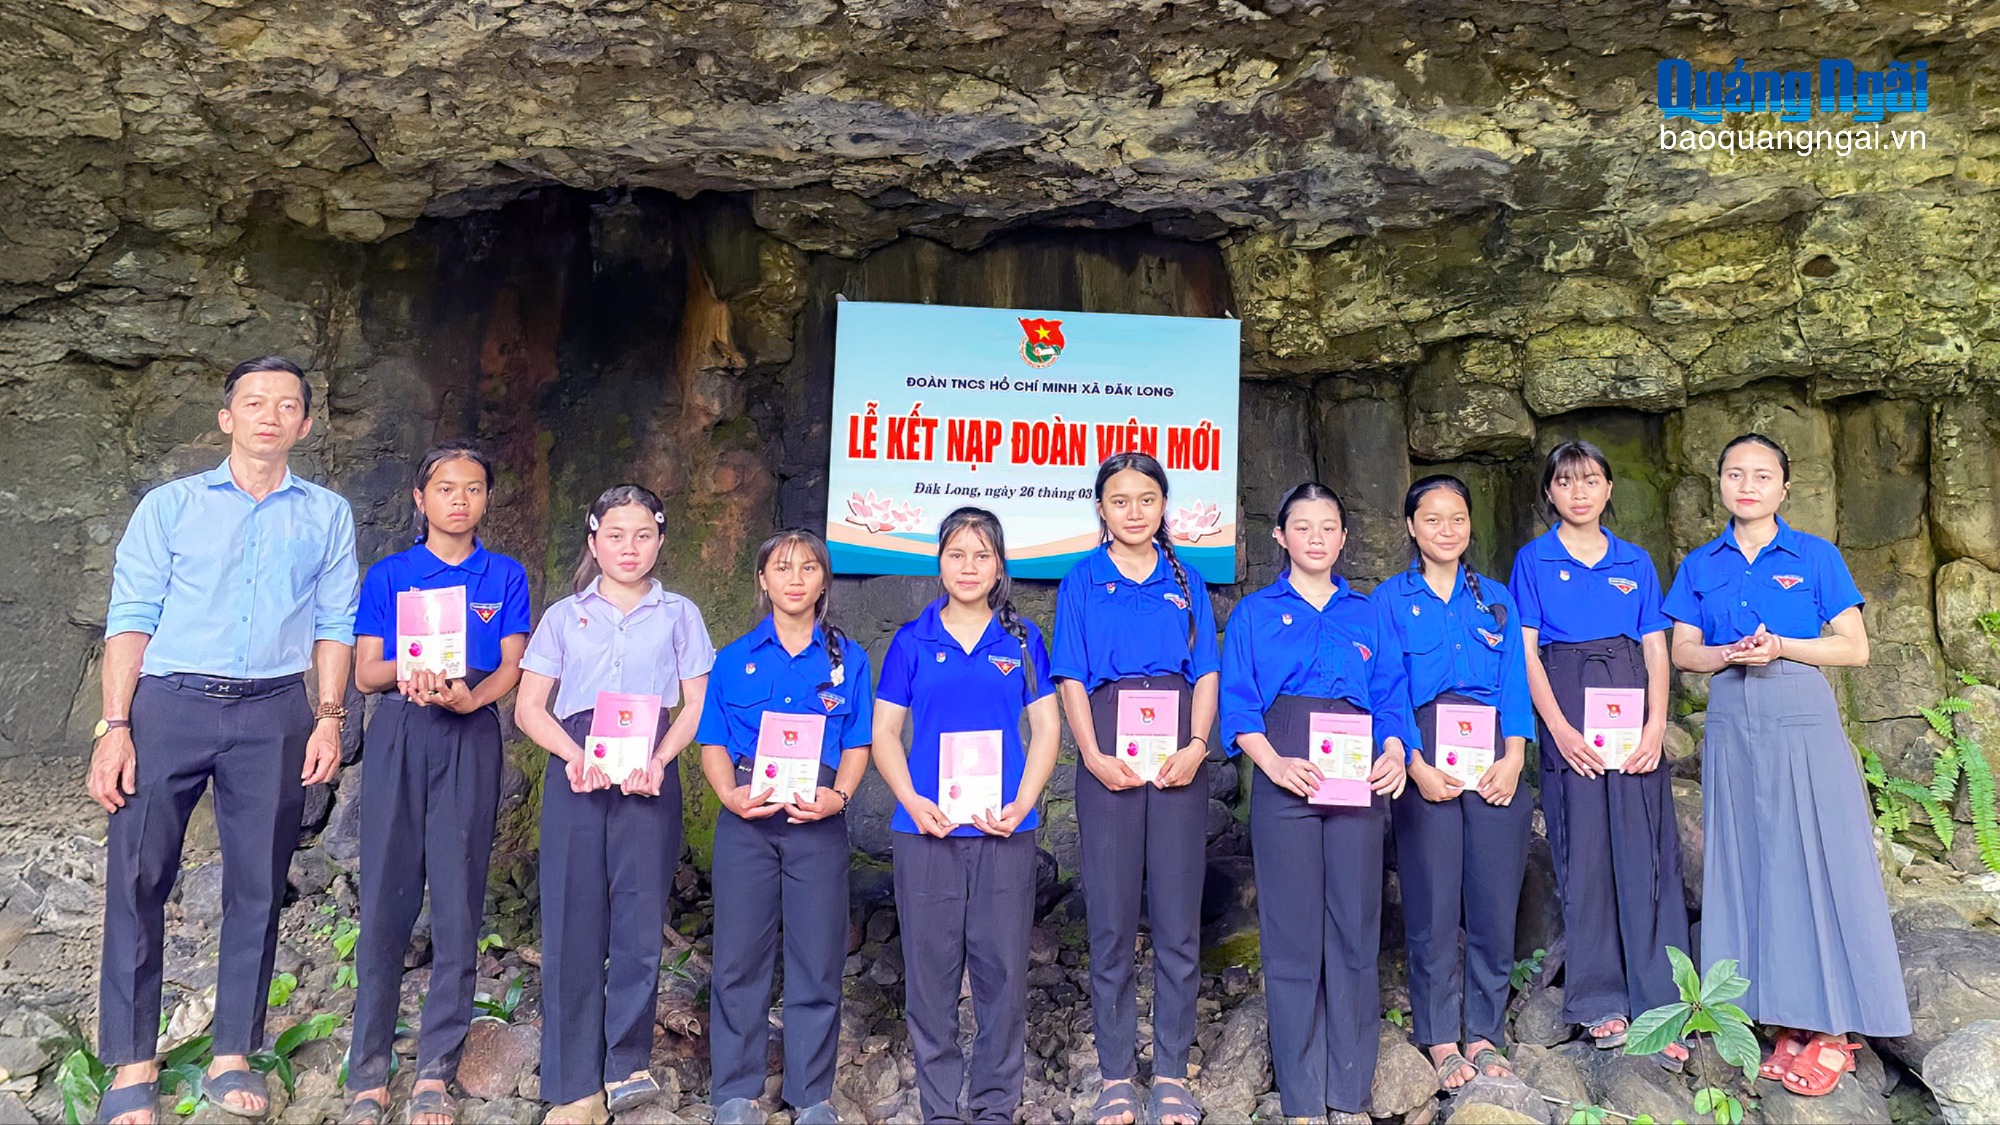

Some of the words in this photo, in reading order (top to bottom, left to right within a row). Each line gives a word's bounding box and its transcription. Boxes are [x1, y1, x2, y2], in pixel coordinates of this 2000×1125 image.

[906, 375, 947, 388] ĐOÀN
[951, 378, 985, 390] TNCS
[1013, 379, 1040, 392] CHÍ
[1042, 382, 1077, 394] MINH
[1081, 382, 1101, 395] XÃ
[1104, 383, 1133, 396] ĐĂK
[1136, 386, 1174, 397] LONG
[848, 402, 878, 459] LỄ
[886, 403, 939, 461] KẾT
[946, 418, 1003, 471] NẠP
[1011, 416, 1088, 467] ĐOÀN
[1095, 417, 1158, 466] VIÊN
[1166, 420, 1221, 471] MỚI
[944, 483, 981, 498] Long,
[984, 485, 1017, 499] ngày
[1019, 486, 1035, 497] 26
[1037, 486, 1077, 501] tháng
[1078, 488, 1093, 499] 03
